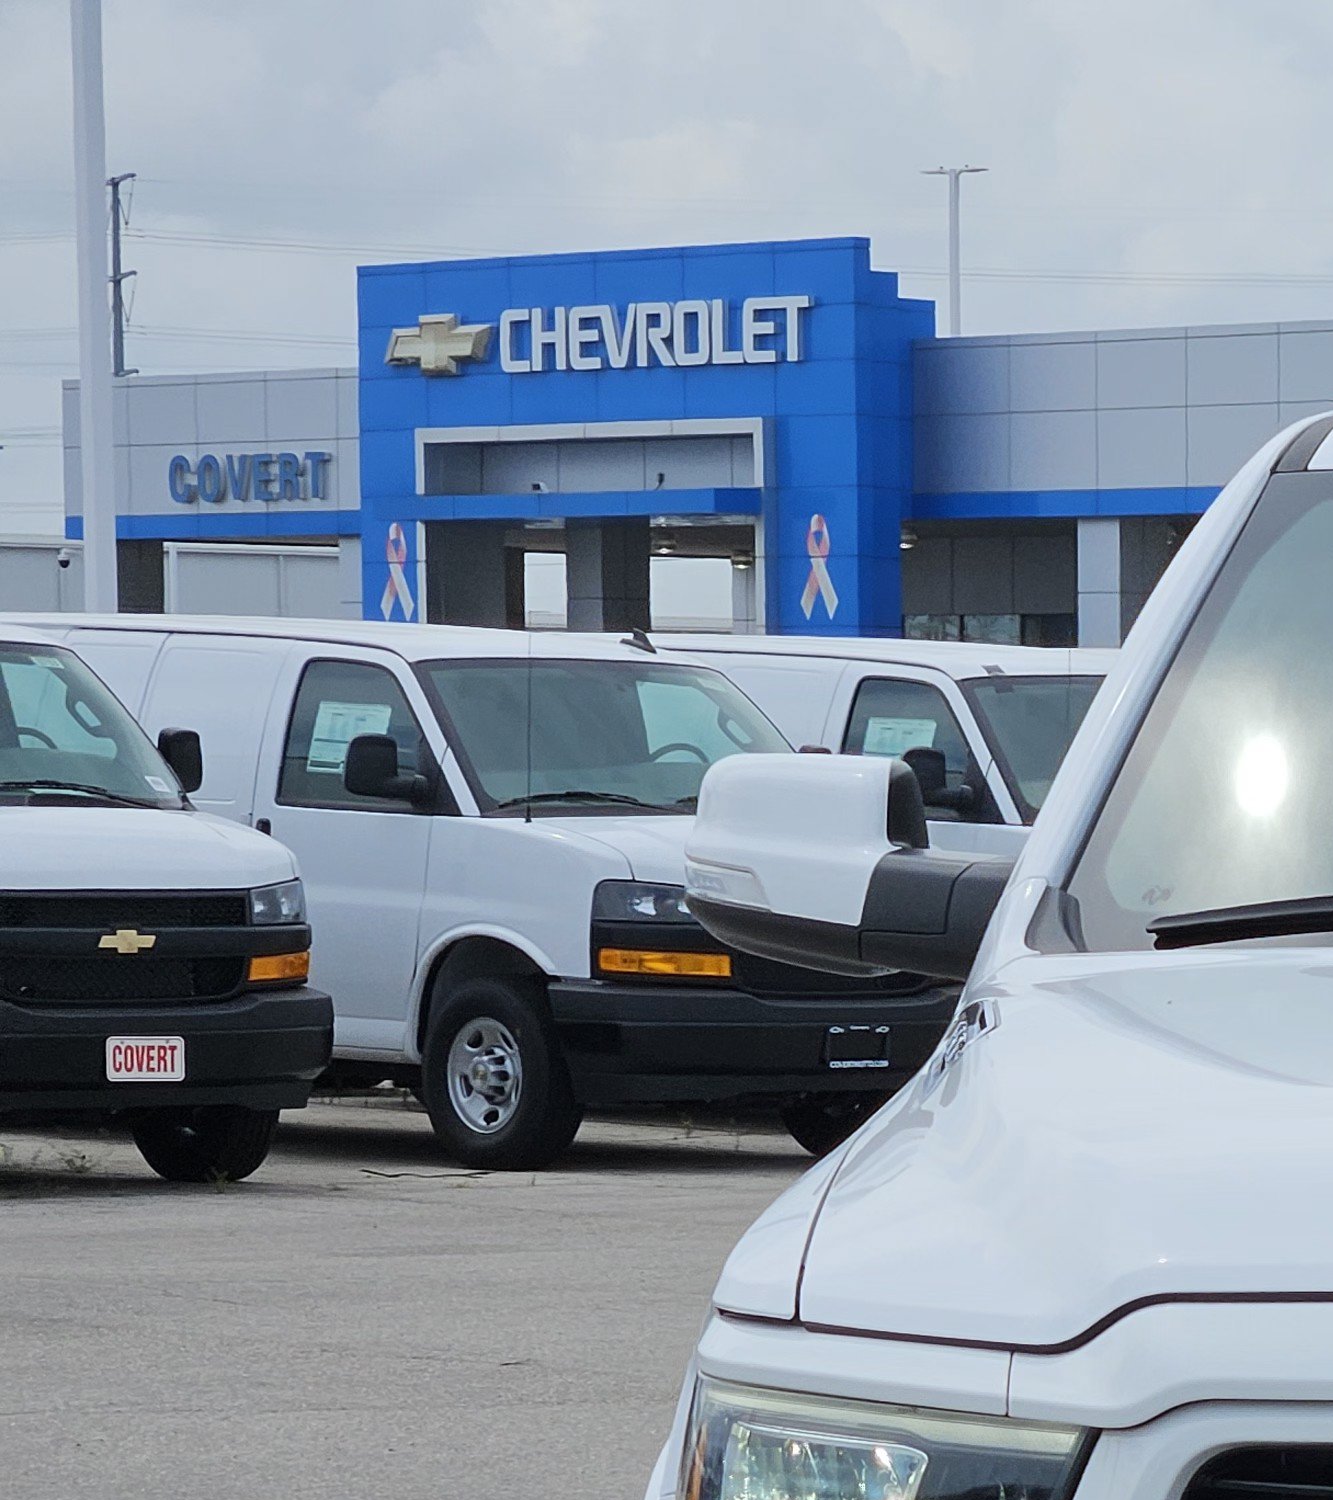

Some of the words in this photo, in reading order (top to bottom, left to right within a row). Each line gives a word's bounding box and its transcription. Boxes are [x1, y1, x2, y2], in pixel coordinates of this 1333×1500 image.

[499, 295, 813, 374] CHEVROLET
[168, 451, 332, 503] COVERT
[112, 1044, 178, 1073] COVERT
